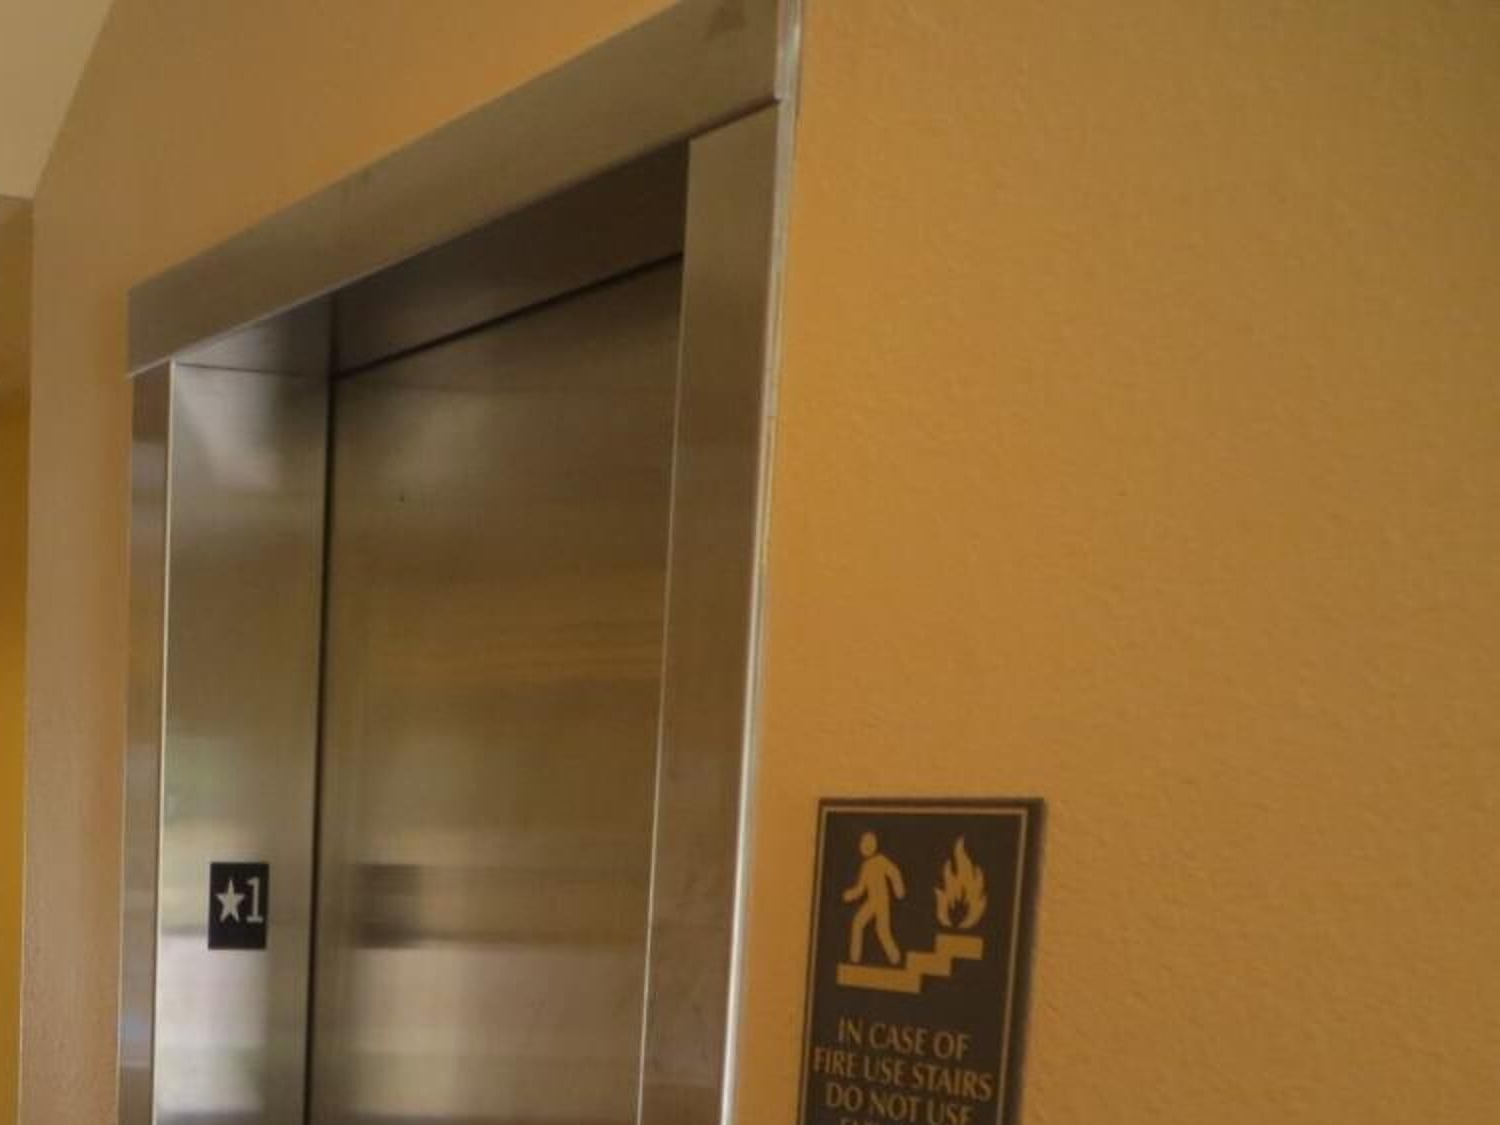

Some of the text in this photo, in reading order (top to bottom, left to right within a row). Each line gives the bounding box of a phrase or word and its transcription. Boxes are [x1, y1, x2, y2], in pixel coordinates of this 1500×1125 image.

[246, 877, 263, 923] 1
[838, 1017, 970, 1060] IN CASE OF
[813, 1047, 994, 1101] FIRE USE STAIRS
[826, 1081, 863, 1111] DO
[870, 1089, 920, 1123] NOT
